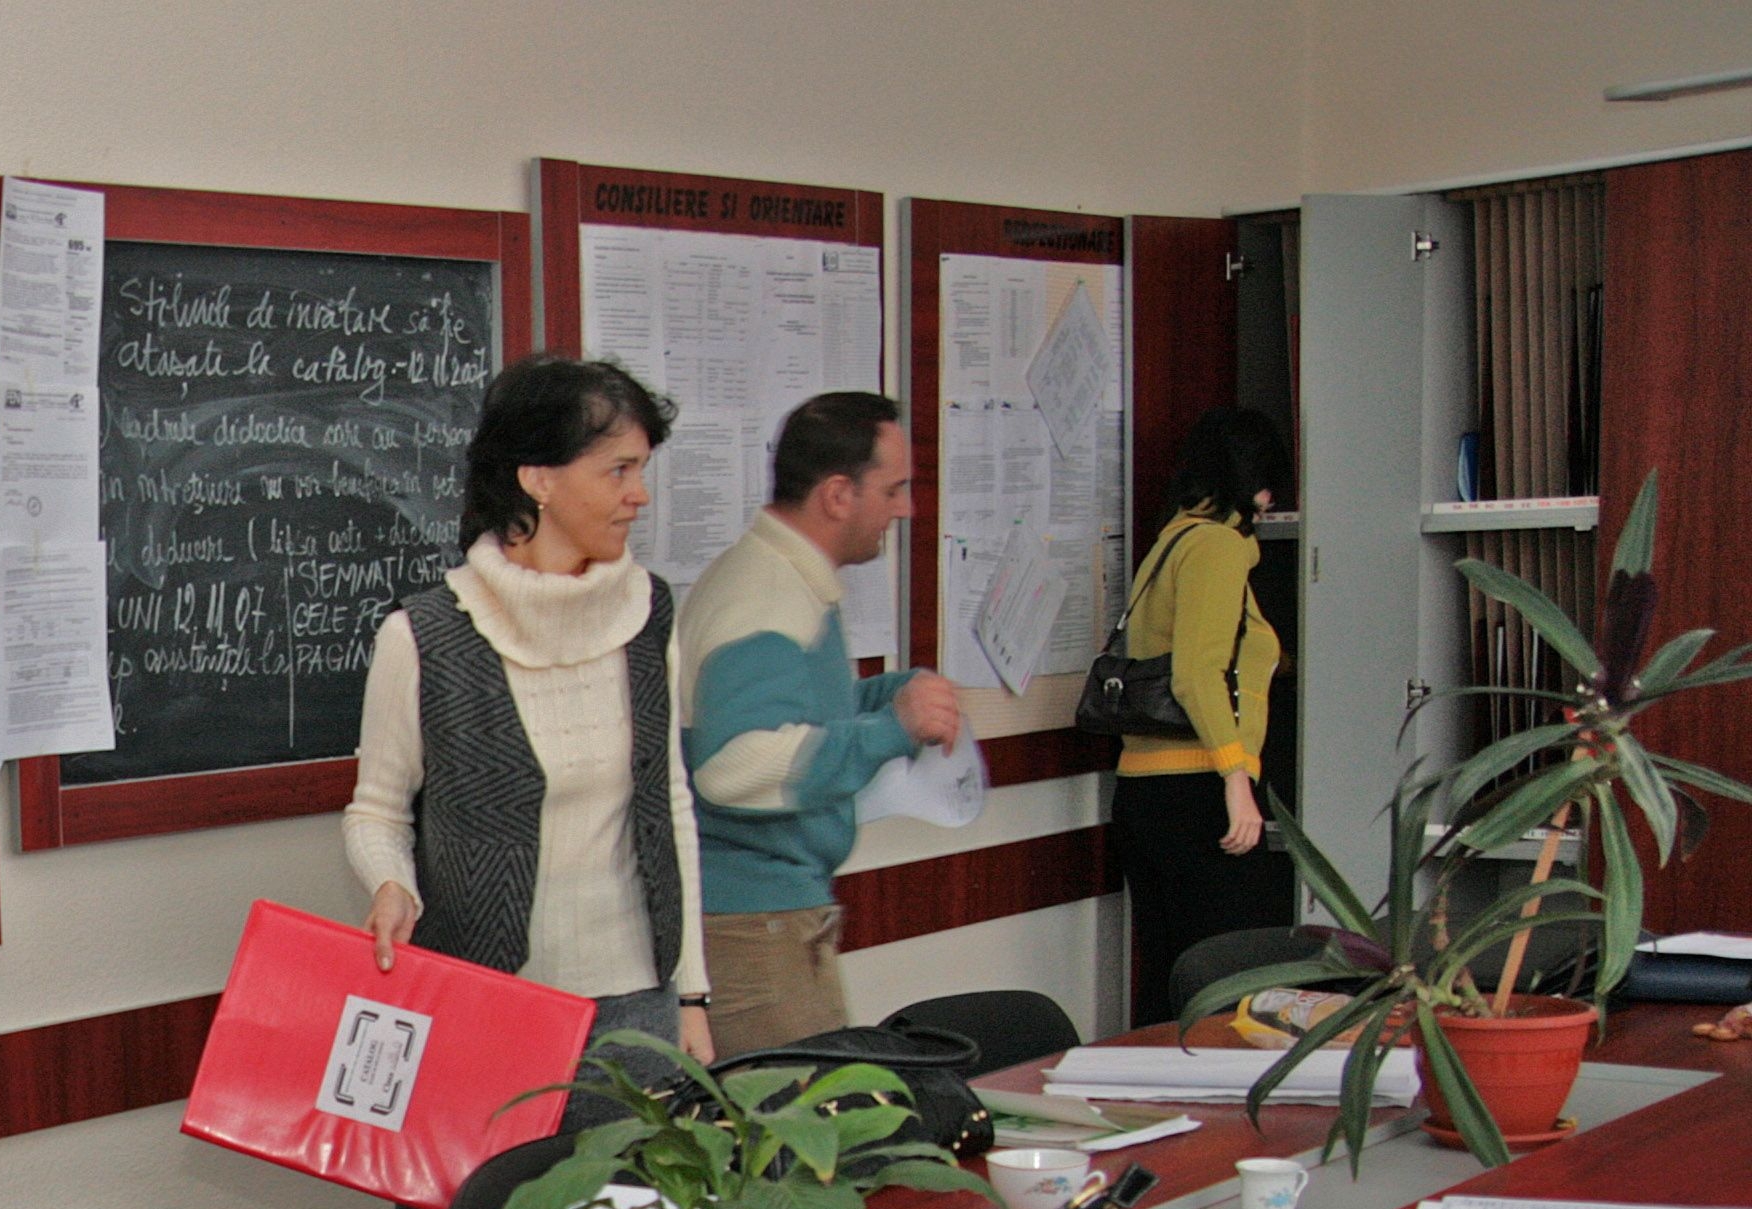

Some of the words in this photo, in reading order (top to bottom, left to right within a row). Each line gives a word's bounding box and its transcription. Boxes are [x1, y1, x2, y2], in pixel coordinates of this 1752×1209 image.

[596, 182, 710, 218] CONSILIERE
[751, 195, 846, 228] ORIENTARE
[247, 290, 277, 328] de
